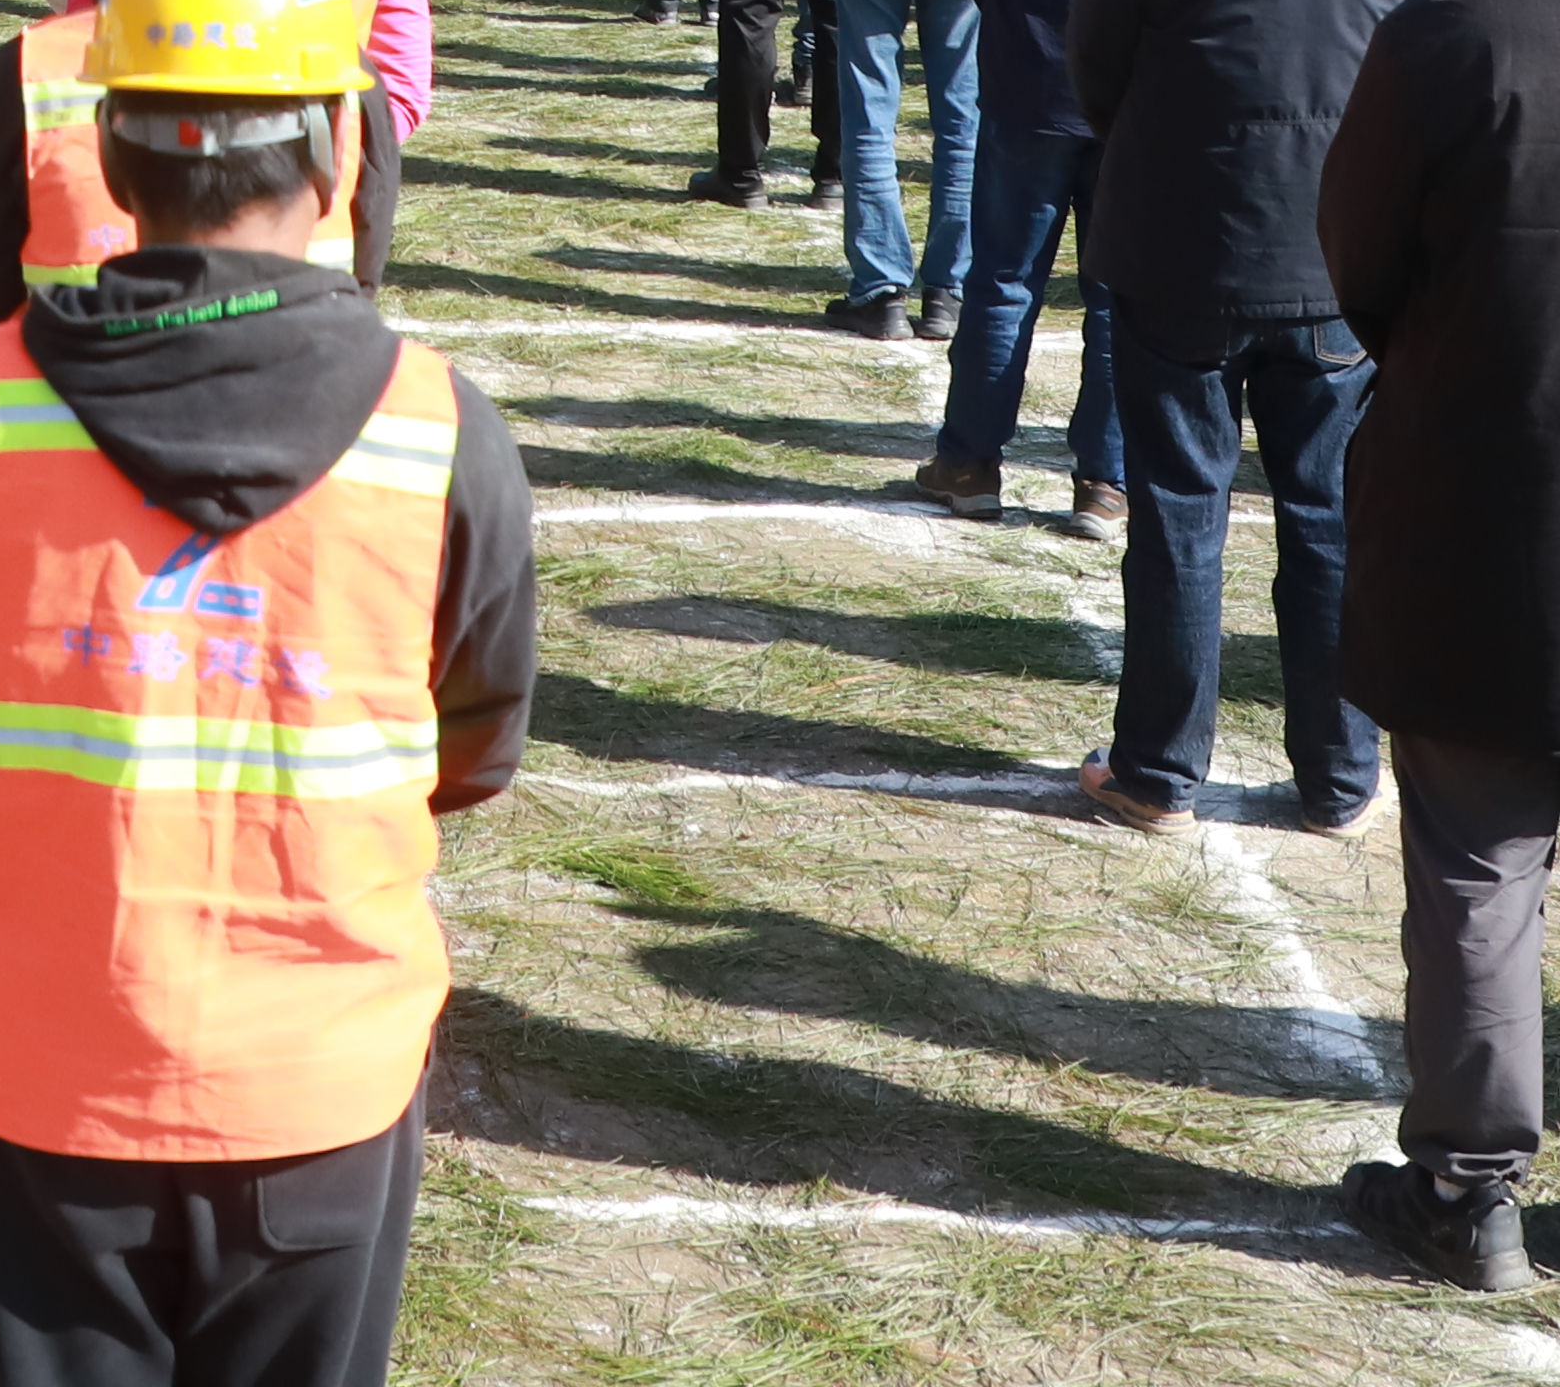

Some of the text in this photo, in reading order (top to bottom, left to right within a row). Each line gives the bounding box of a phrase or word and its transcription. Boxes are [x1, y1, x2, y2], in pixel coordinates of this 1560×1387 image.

[146, 22, 259, 49] 中路建设
[63, 622, 333, 699] 中路建设
